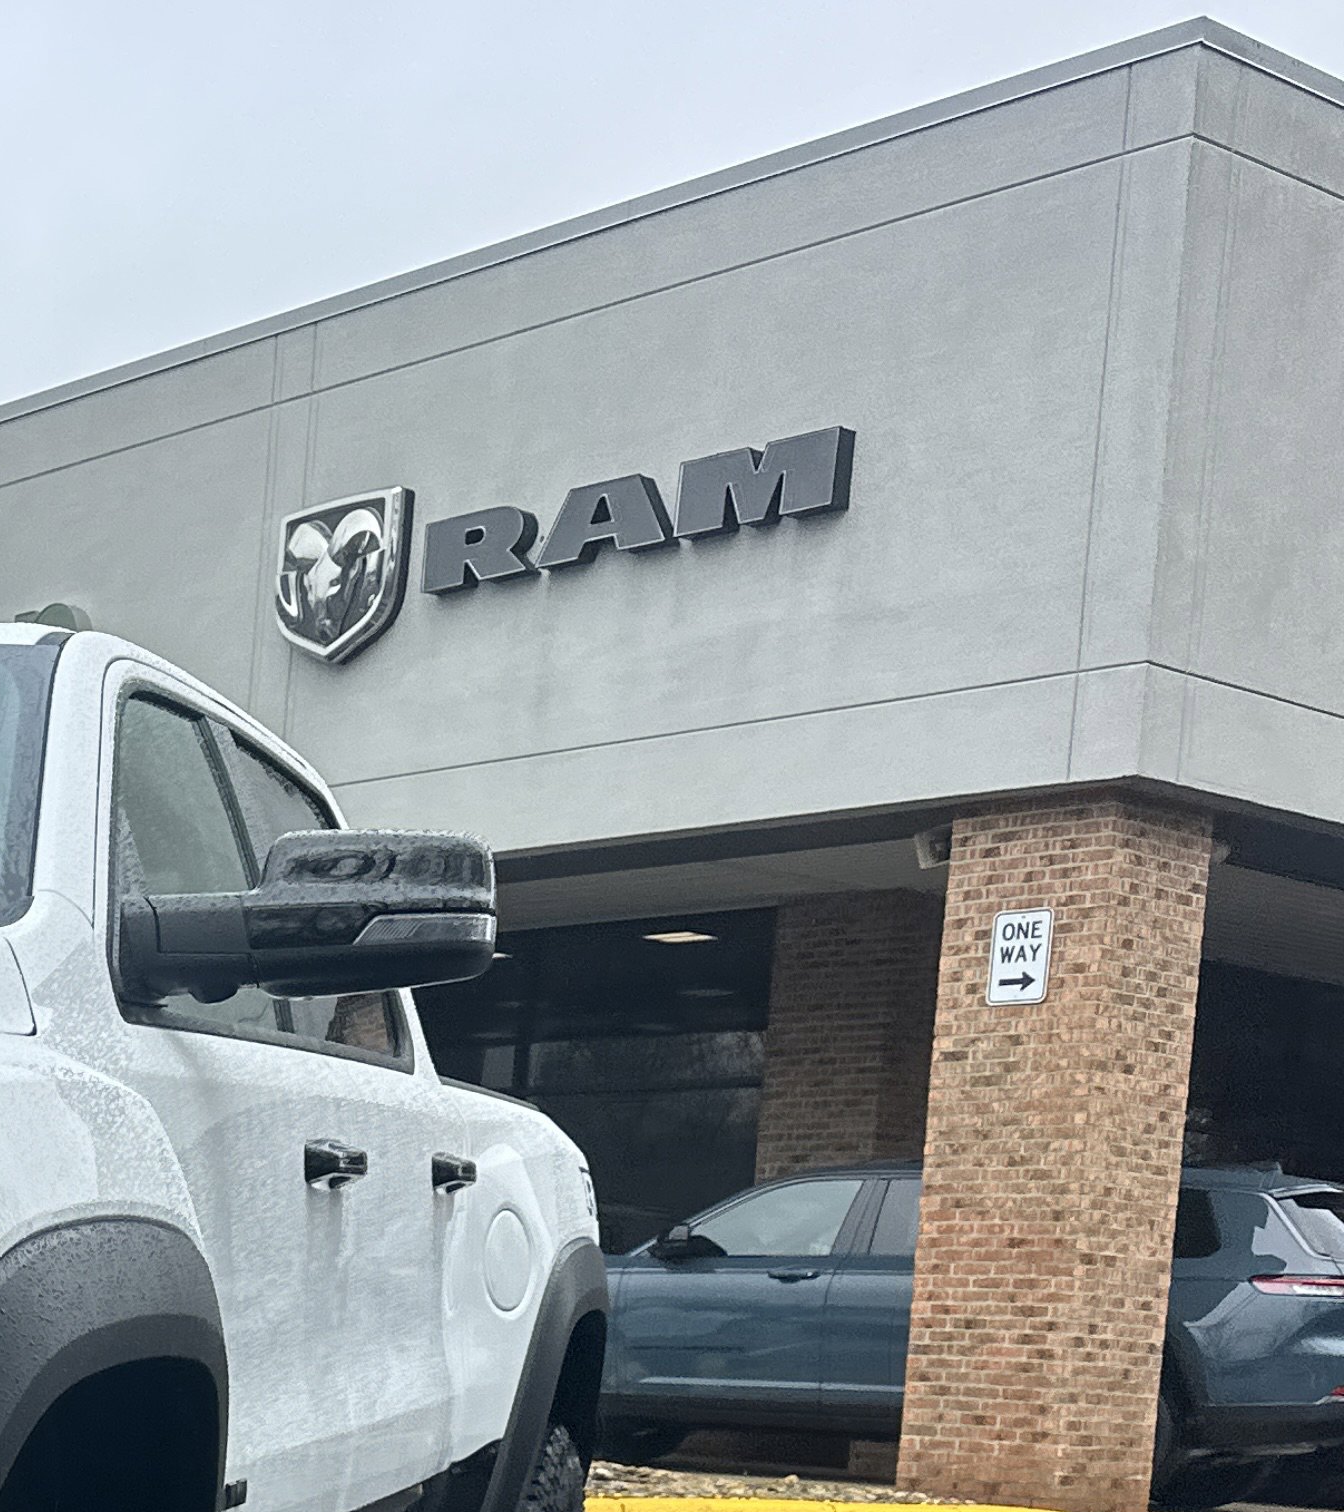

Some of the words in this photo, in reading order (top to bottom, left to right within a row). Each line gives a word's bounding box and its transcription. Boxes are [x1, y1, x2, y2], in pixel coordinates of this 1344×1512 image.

[421, 425, 856, 594] RAM
[1002, 920, 1043, 941] ONE
[1000, 943, 1042, 964] WAY
